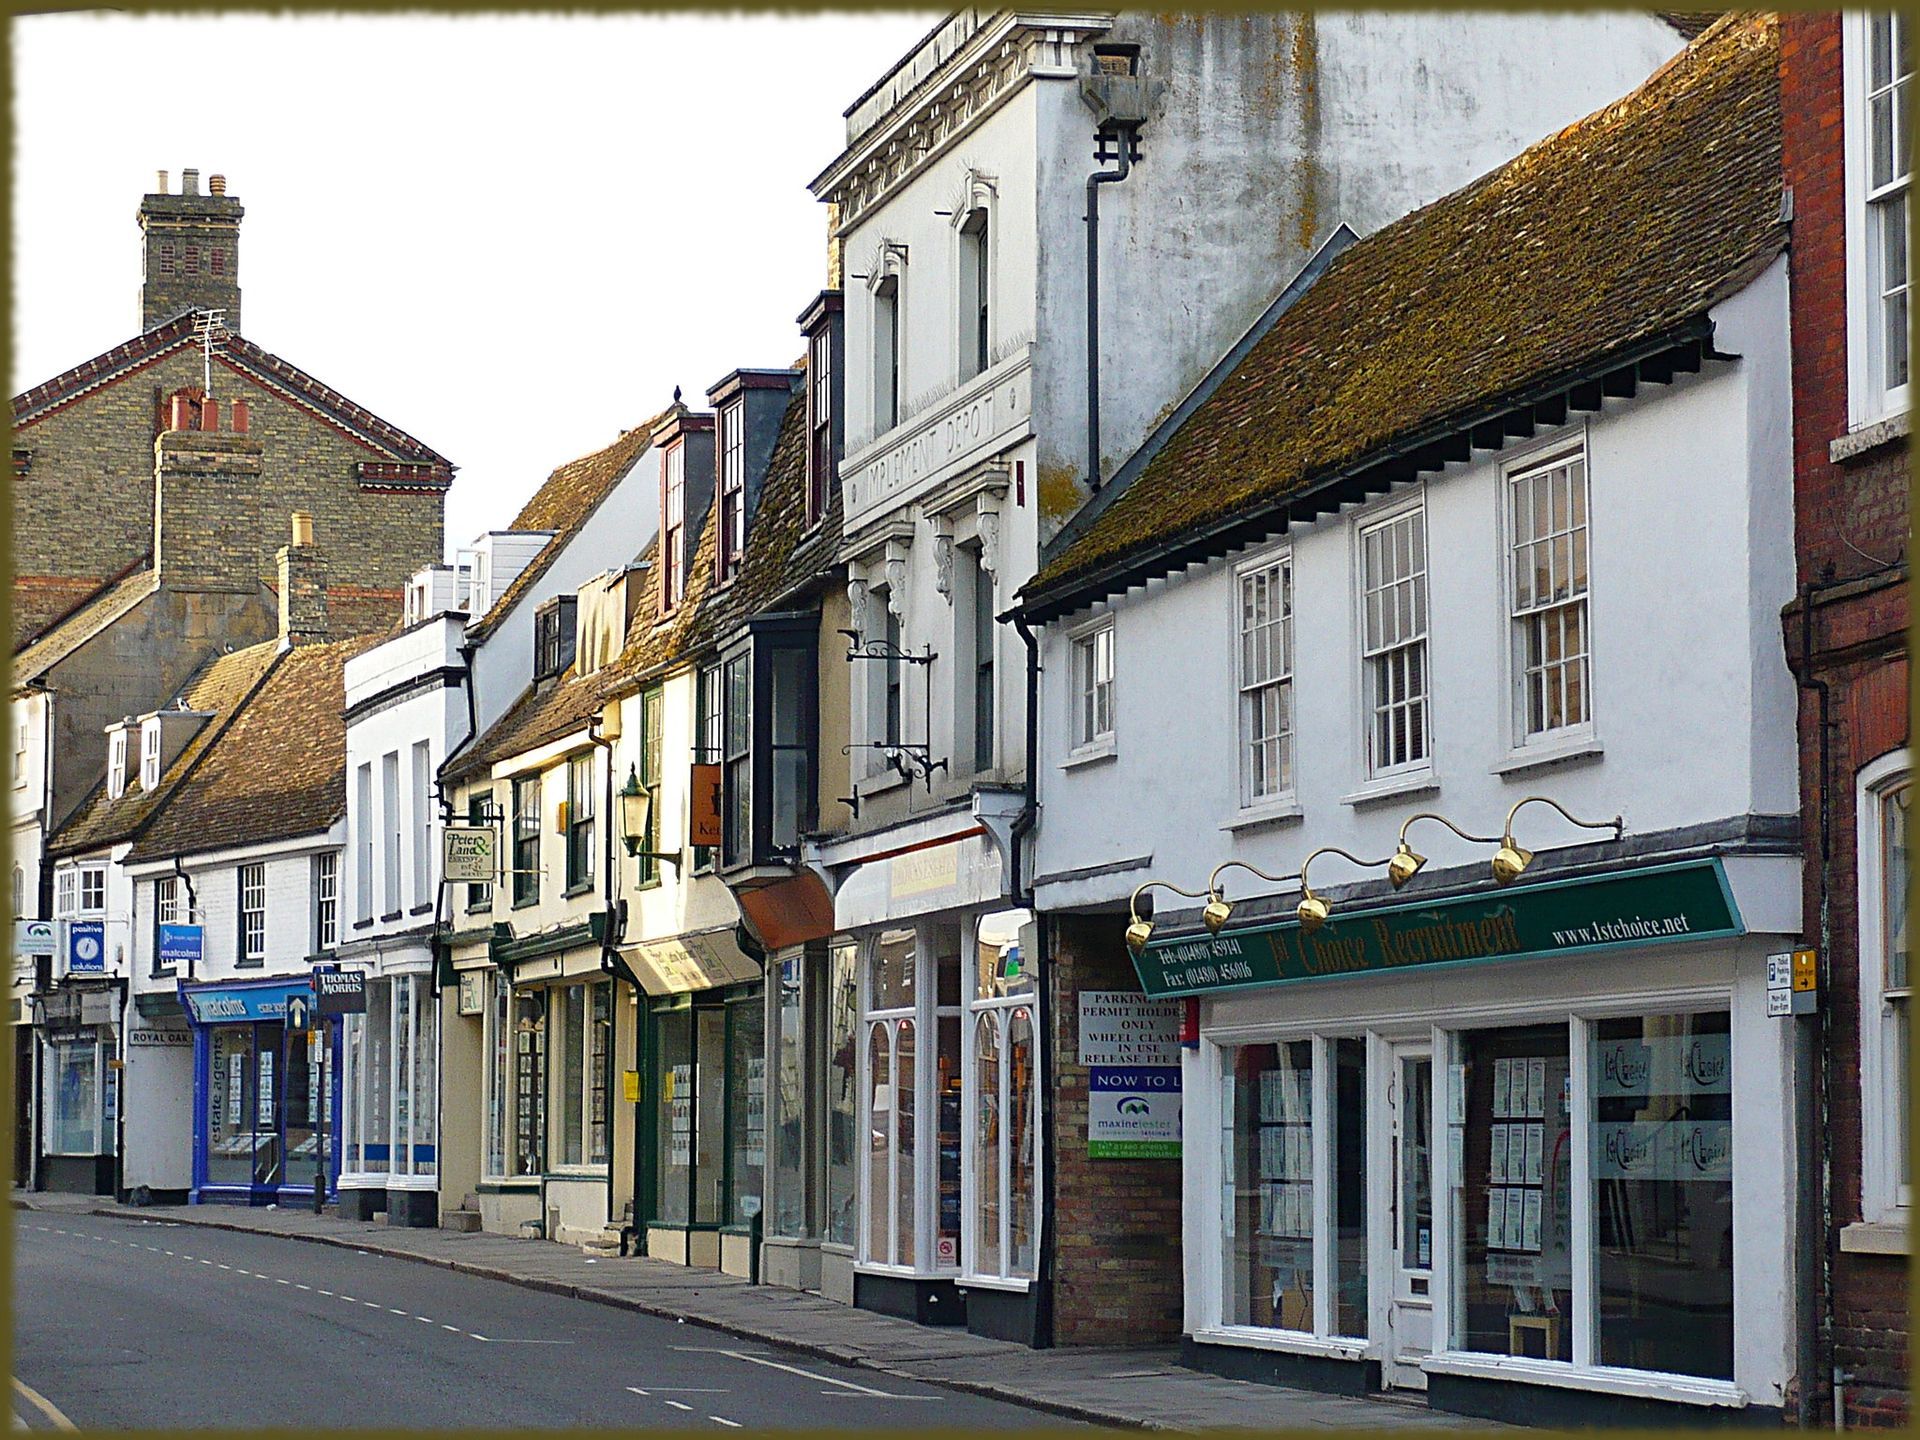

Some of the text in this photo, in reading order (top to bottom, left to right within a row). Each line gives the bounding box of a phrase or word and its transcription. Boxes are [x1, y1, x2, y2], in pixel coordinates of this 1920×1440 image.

[867, 396, 993, 502] IMPLEMENT DEPOT
[72, 925, 103, 934] positive
[1552, 912, 1690, 945] www.1stchoice.net
[1373, 908, 1522, 965] Recruitment
[161, 949, 201, 958] malcolms
[1157, 938, 1243, 965] Tel: (01480) 459141
[72, 963, 103, 971] solutions
[320, 973, 361, 984] THOMAS
[1162, 961, 1253, 988] Fax: (01480) 456016
[322, 983, 362, 995] MORRIS
[203, 995, 246, 1016] malcolms
[1083, 1007, 1130, 1017] PERMIT
[1121, 1021, 1155, 1030] ONLY
[134, 1033, 188, 1042] ROYAL OAK
[1089, 1033, 1133, 1042] WHEEL
[1118, 1044, 1160, 1053] IN USE
[1085, 1054, 1140, 1063] RELEASE
[1147, 1055, 1170, 1063] FEE
[1098, 1075, 1138, 1086] NOW
[1144, 1075, 1166, 1087] TO
[211, 1036, 225, 1143] estate agents
